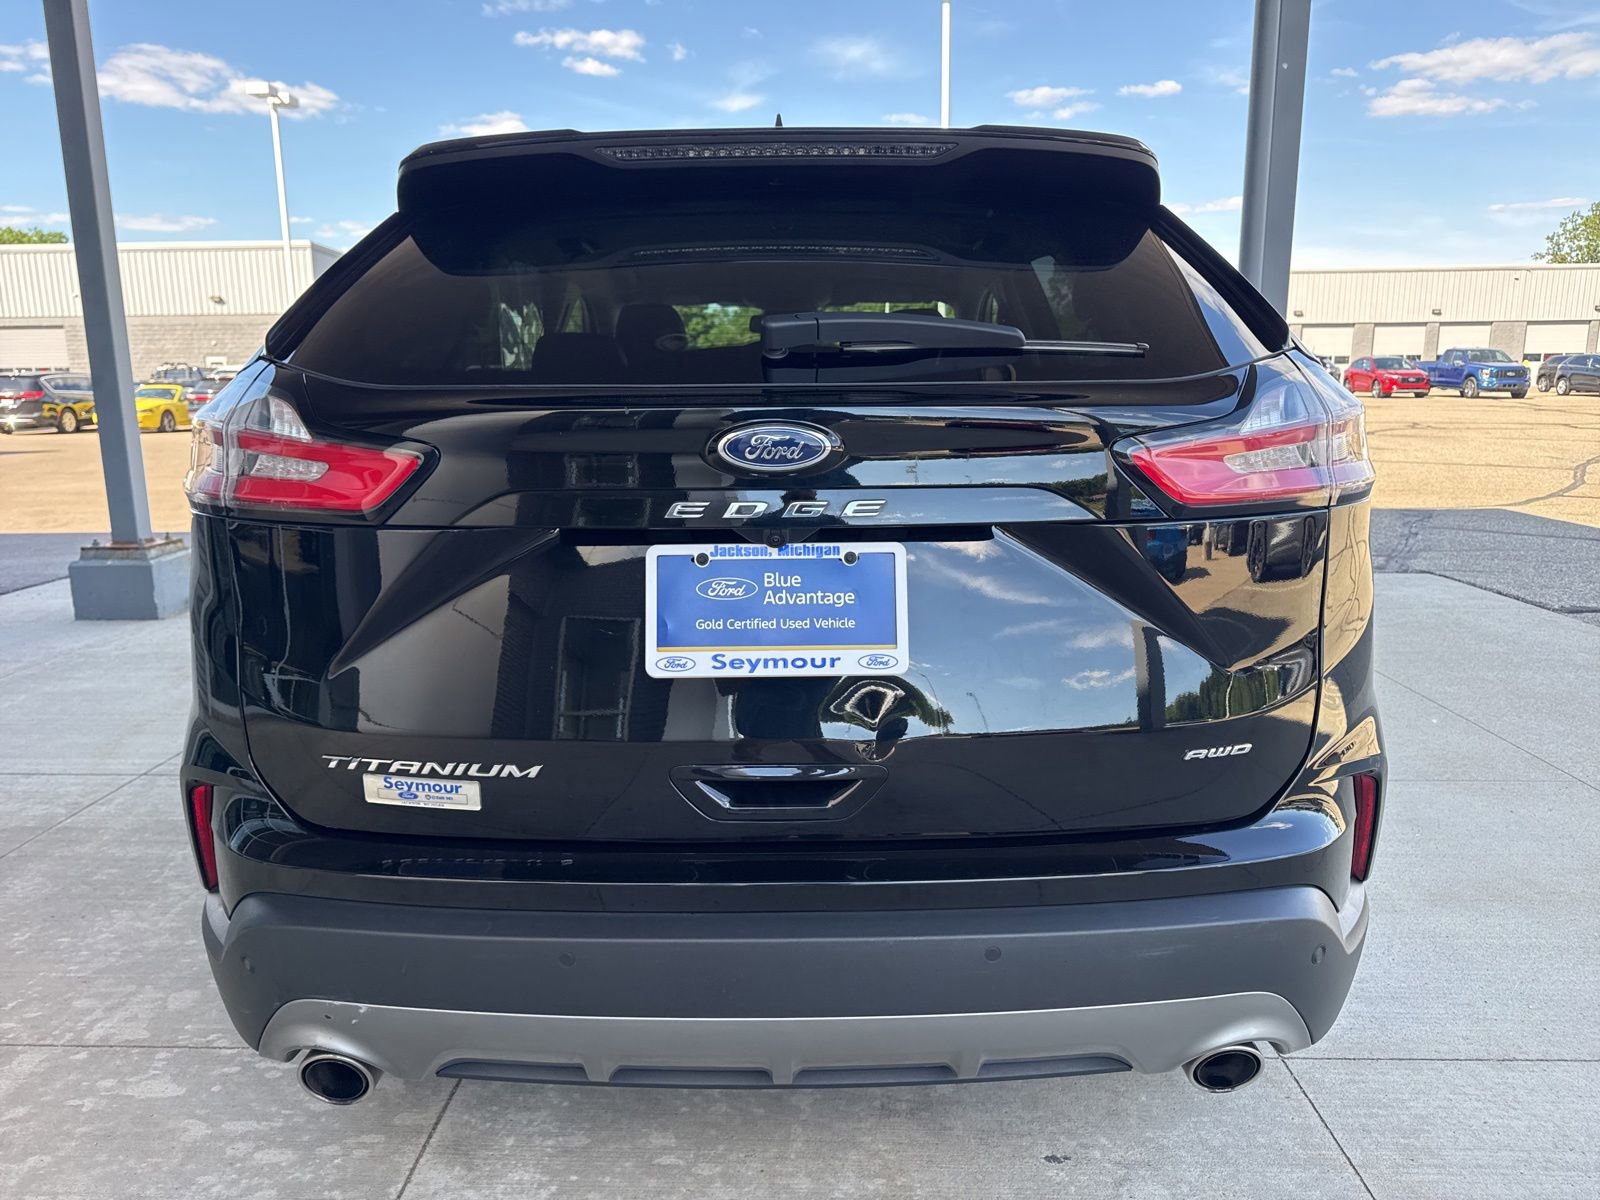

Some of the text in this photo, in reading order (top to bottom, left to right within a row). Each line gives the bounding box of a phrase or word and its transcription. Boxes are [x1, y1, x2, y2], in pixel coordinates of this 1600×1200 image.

[744, 434, 804, 460] Ford
[664, 499, 887, 519] EDGE
[710, 544, 841, 558] Jackson, Michigan
[707, 580, 746, 597] Ford
[763, 572, 802, 588] Blue
[763, 589, 856, 607] Advantage
[695, 617, 856, 630] Gold Certified Used Vehicle
[711, 653, 842, 673] Seymour
[1183, 743, 1253, 761] AWD
[321, 755, 544, 779] TITANIUM
[383, 775, 463, 794] Seymour
